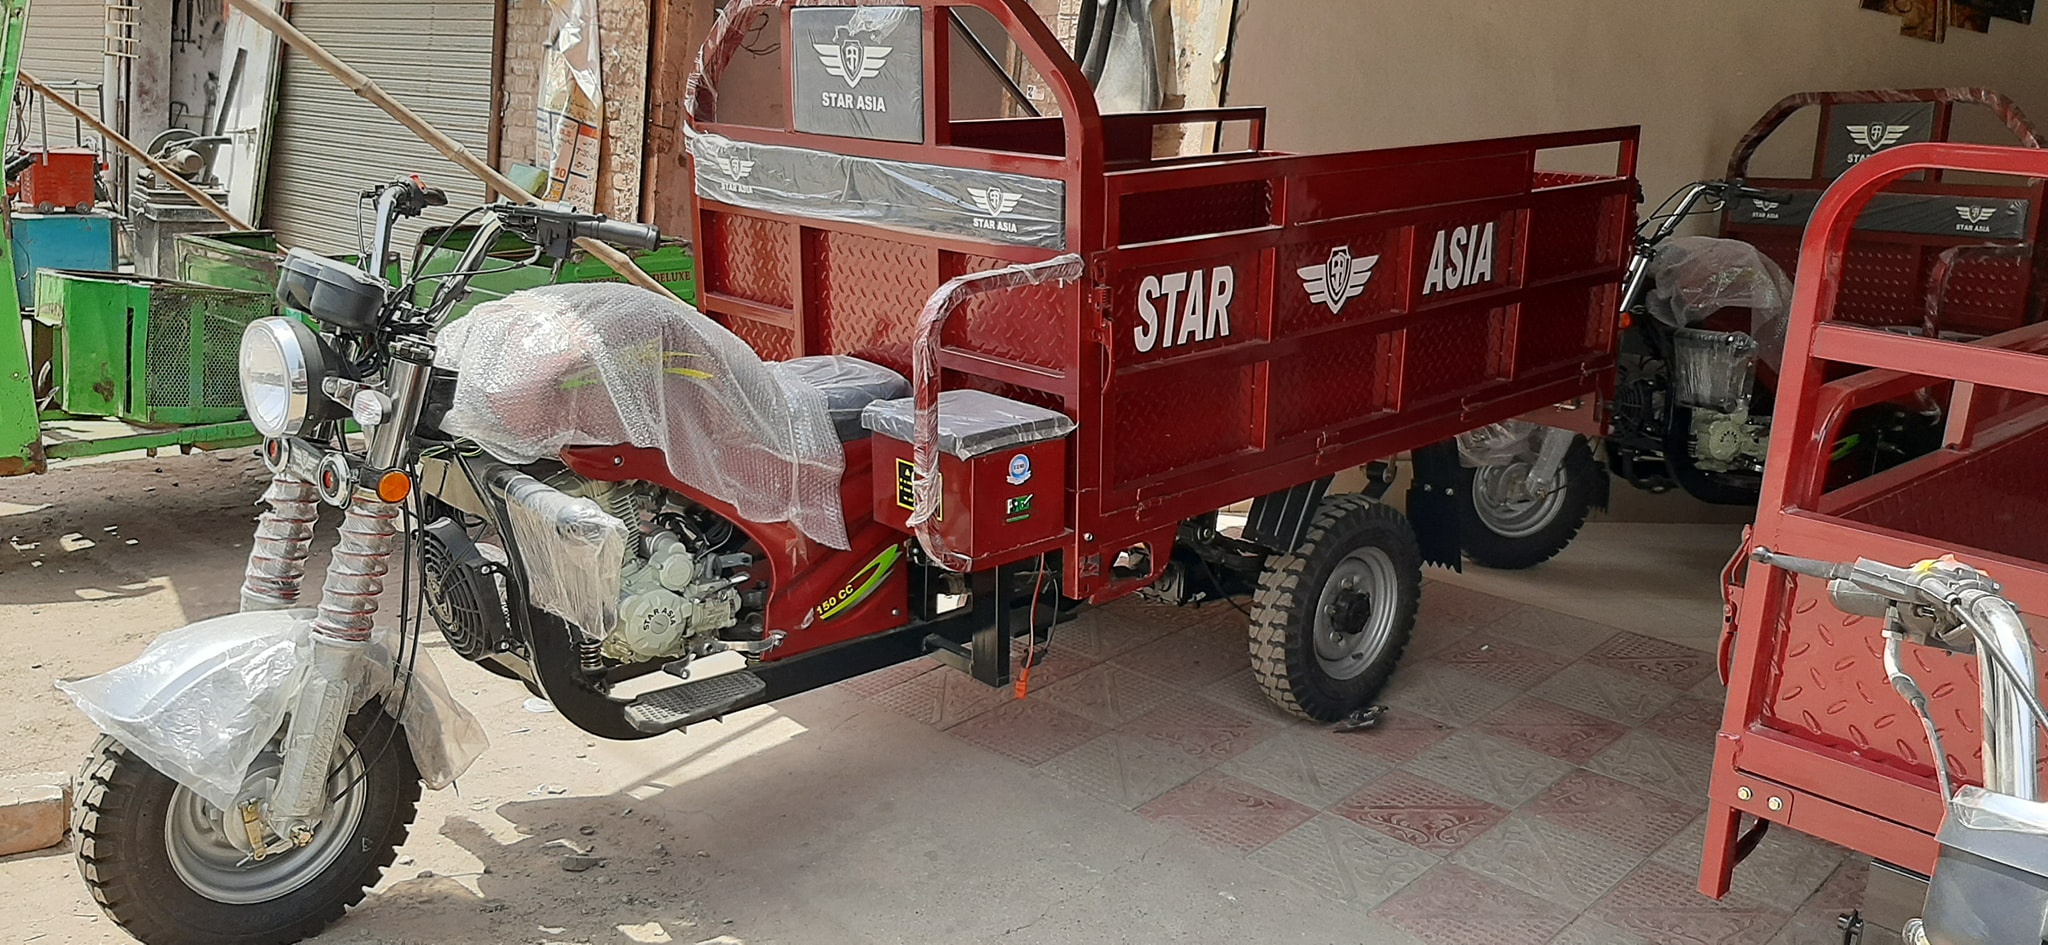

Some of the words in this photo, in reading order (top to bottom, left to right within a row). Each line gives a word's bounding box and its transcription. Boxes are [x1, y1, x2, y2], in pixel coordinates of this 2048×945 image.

[822, 91, 854, 109] STAR
[856, 95, 887, 113] ASIA
[1847, 153, 1871, 164] STA
[973, 217, 995, 230] STAR
[996, 221, 1018, 233] ASIA
[1955, 223, 1973, 231] STAR
[1973, 224, 1990, 233] ASIA
[654, 270, 691, 283] DELUXE
[1134, 265, 1234, 353] STAR
[1422, 222, 1494, 295] ASIA
[816, 596, 837, 615] 150
[838, 584, 854, 600] CC
[643, 608, 660, 631] STAR
[661, 607, 677, 626] ASIA
